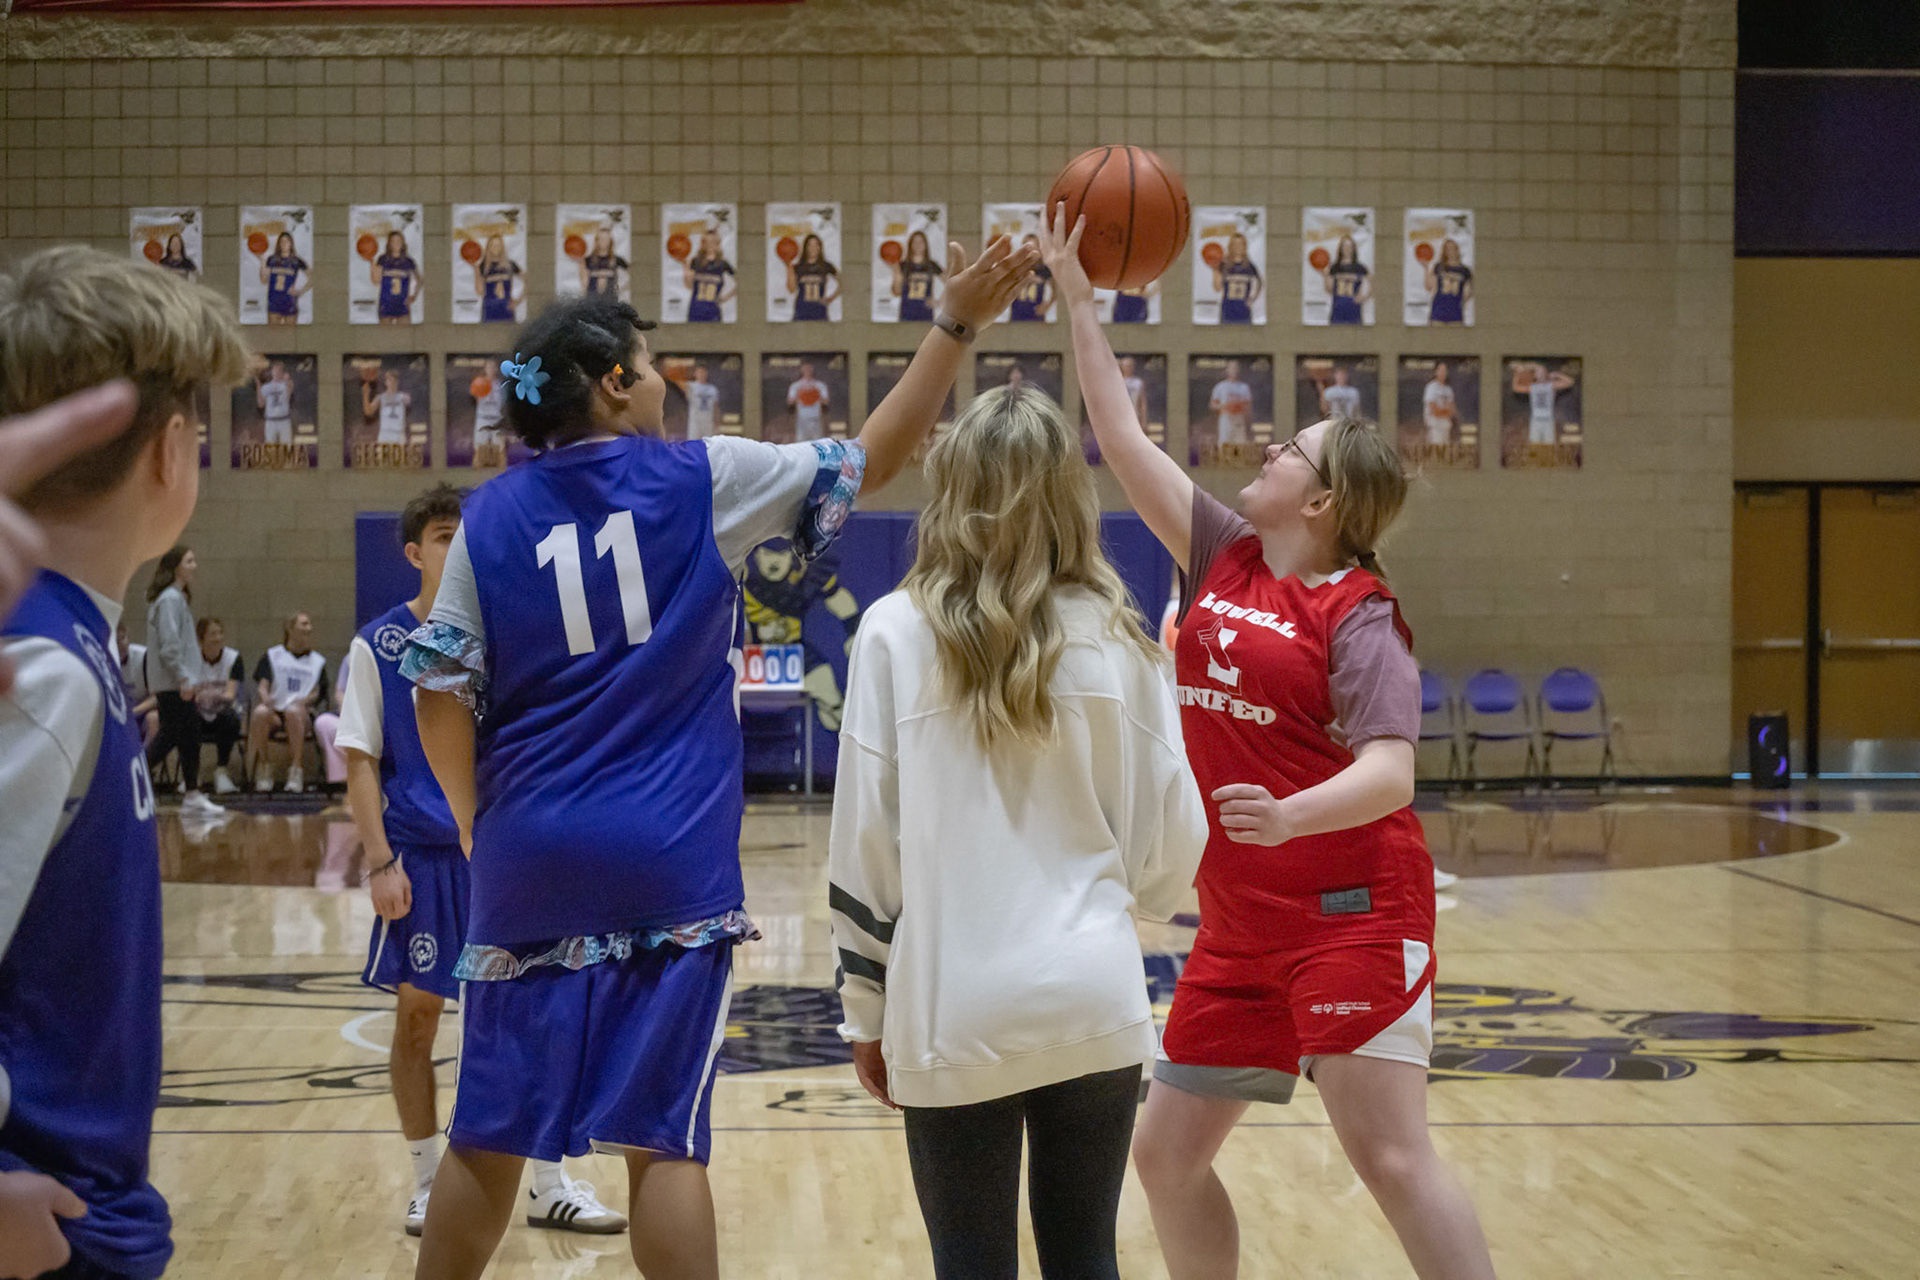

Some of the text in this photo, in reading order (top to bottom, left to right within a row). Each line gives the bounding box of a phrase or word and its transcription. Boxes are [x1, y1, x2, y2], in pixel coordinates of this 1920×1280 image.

[241, 443, 307, 468] POSTMA
[535, 510, 653, 656] 11
[1198, 591, 1297, 639] LOWELL
